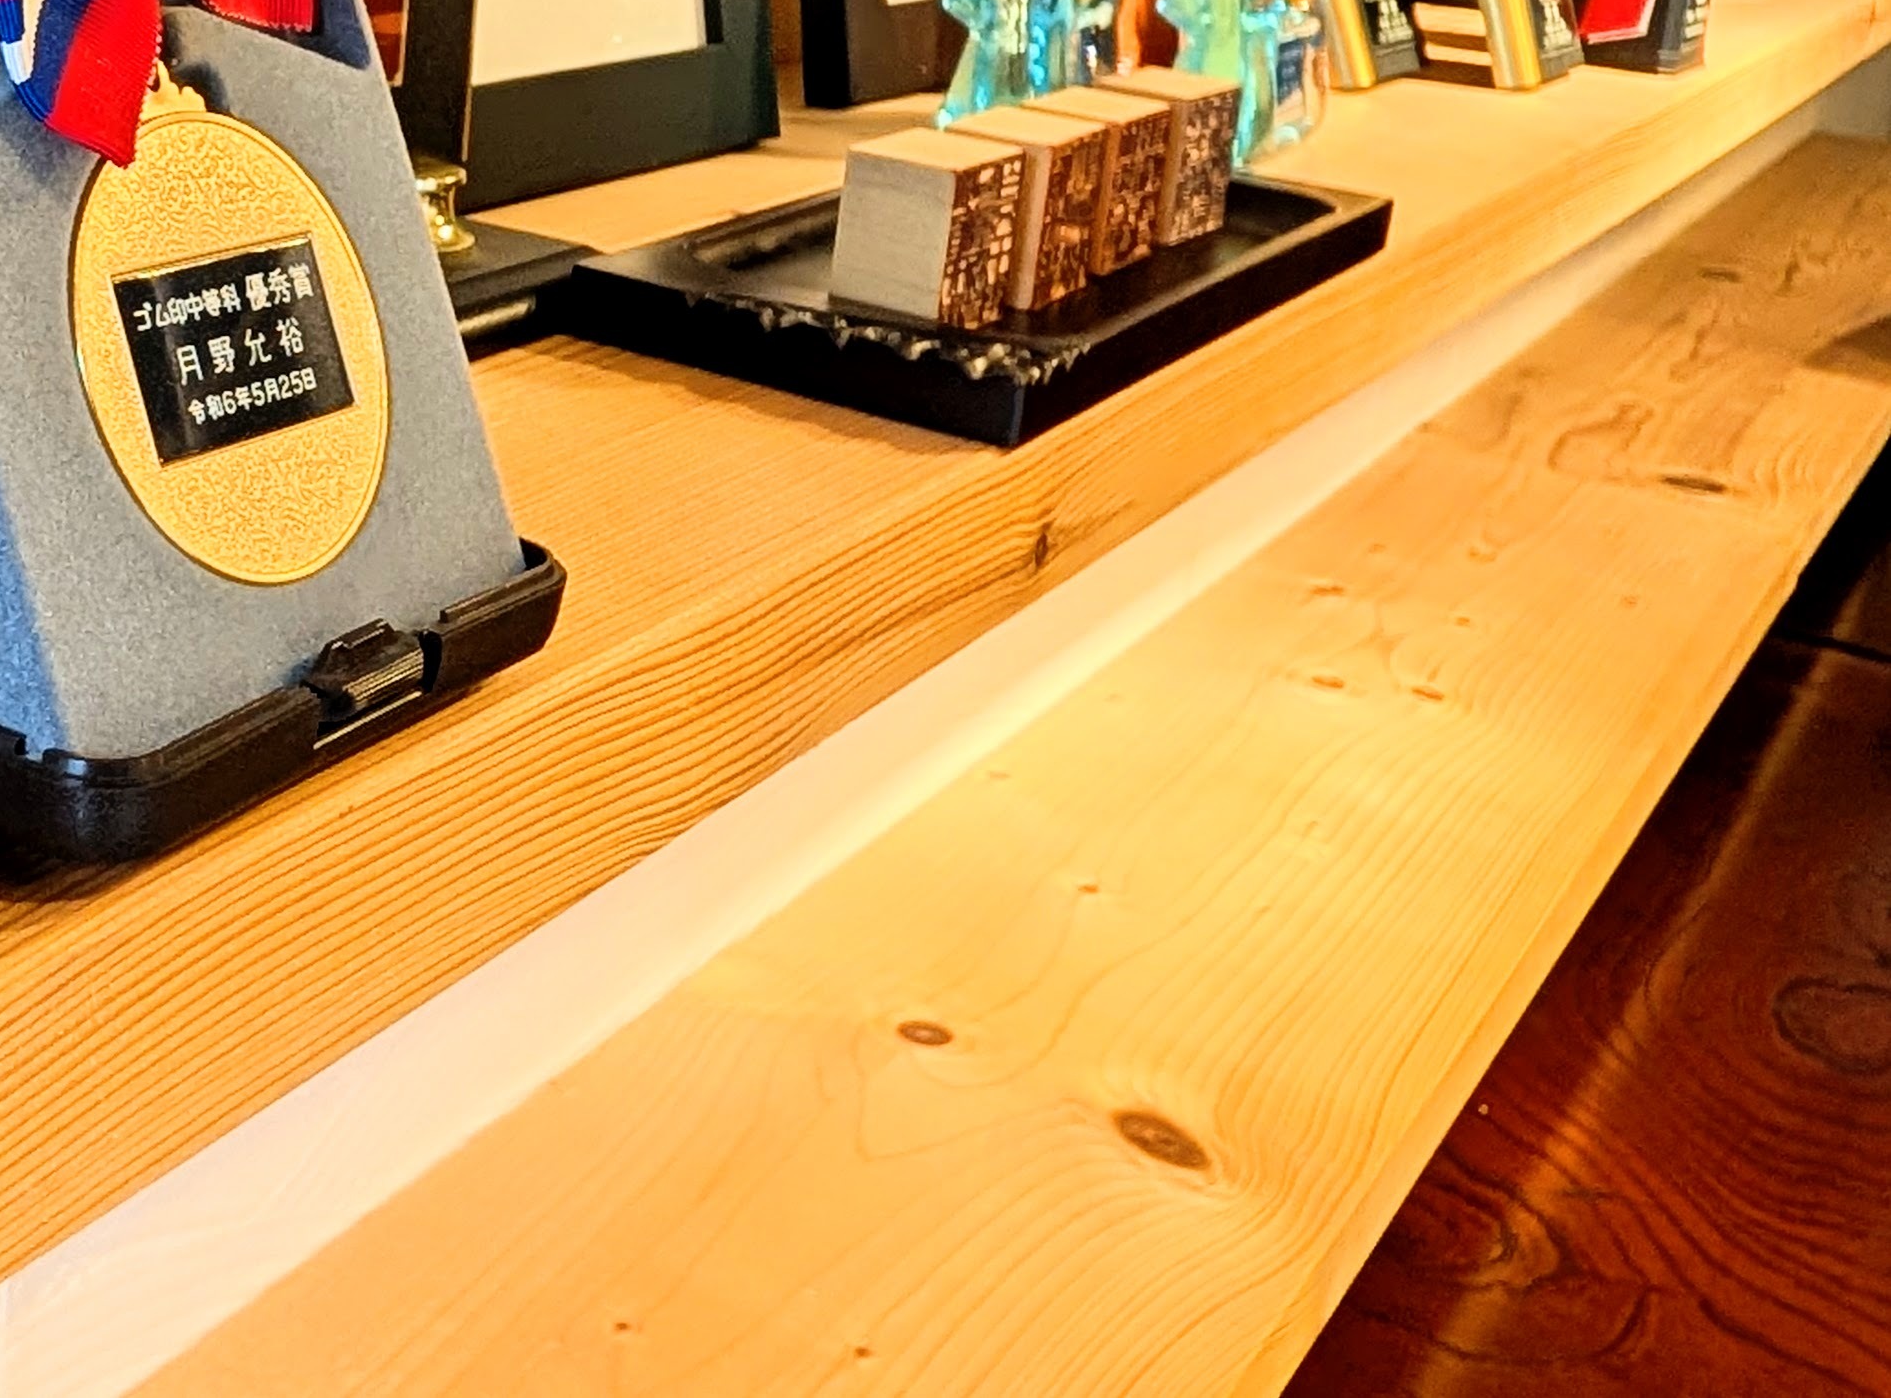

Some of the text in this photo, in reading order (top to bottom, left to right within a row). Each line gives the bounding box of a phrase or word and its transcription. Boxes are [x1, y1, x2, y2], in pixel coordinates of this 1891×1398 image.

[132, 262, 315, 332] ゴム印中等科 優秀賞
[187, 366, 318, 426] 令和6年5月25日
